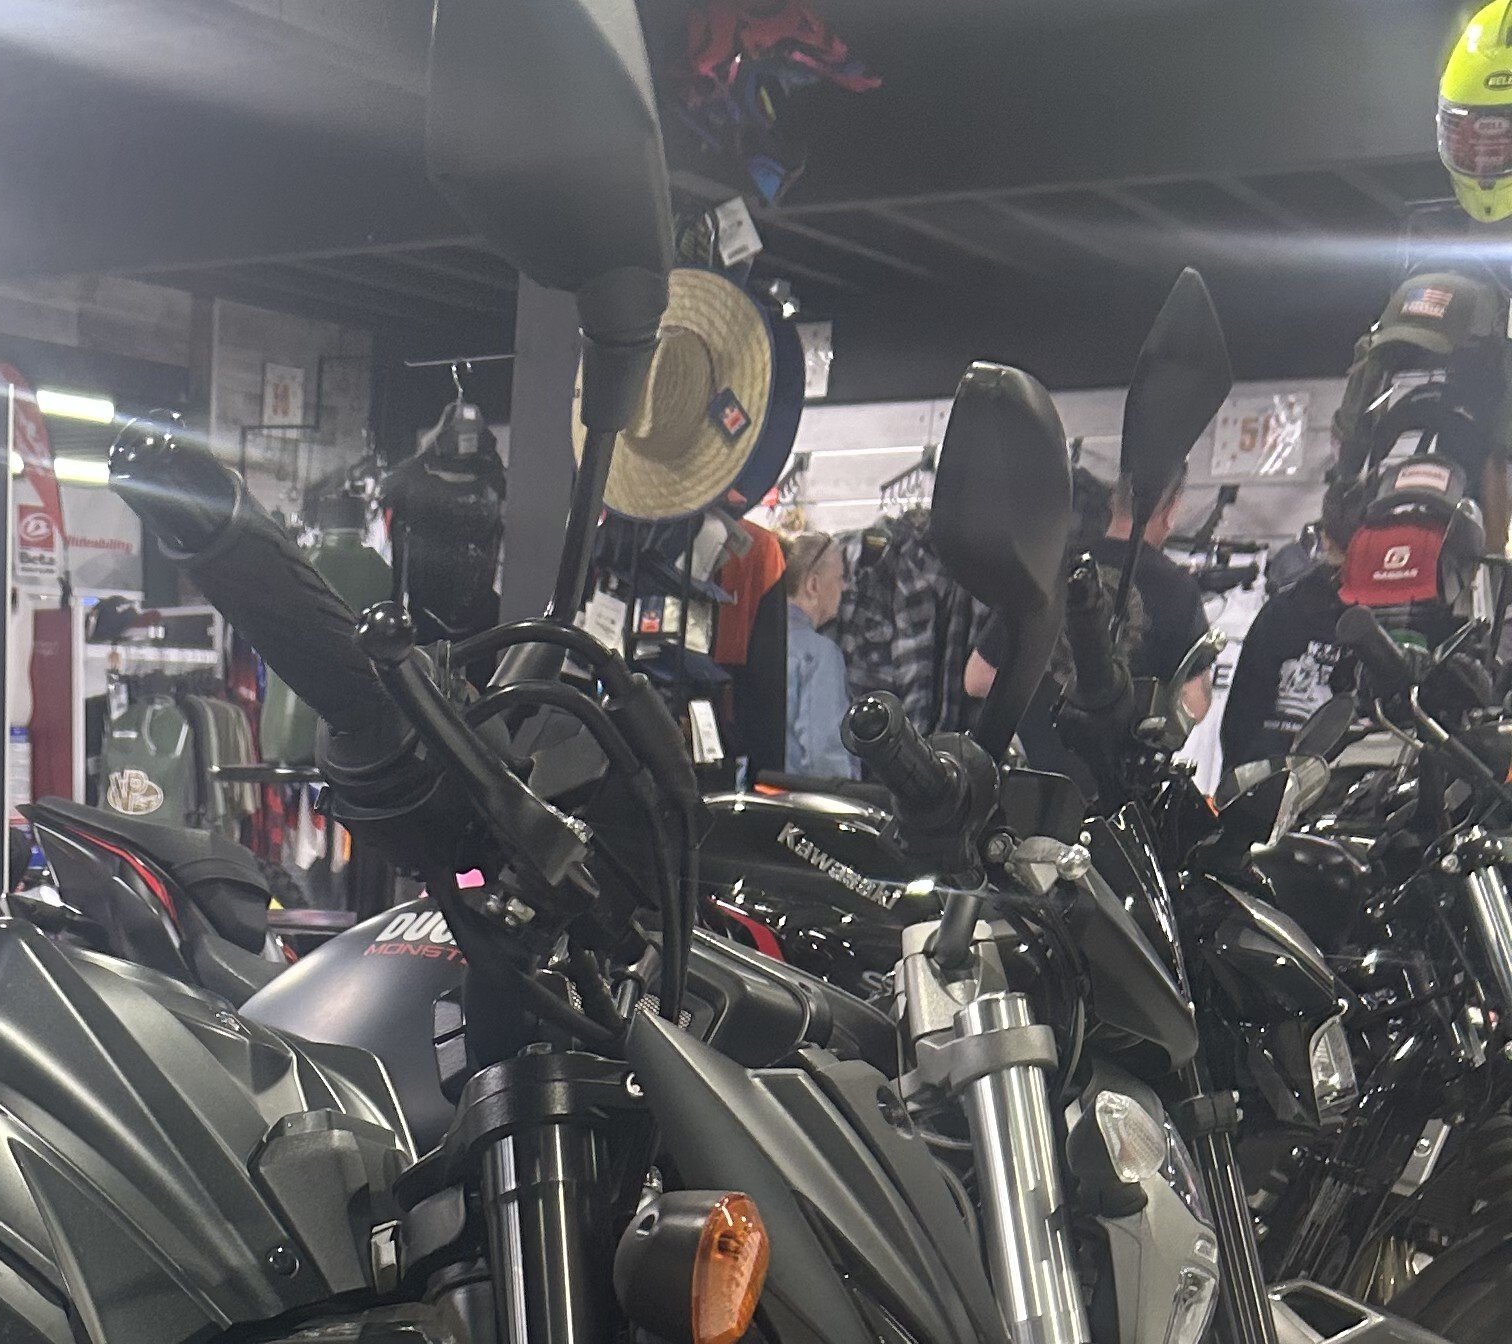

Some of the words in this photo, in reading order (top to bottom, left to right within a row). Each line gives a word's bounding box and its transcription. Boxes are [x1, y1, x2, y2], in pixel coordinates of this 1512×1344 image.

[777, 822, 903, 910] Kawasaki
[375, 911, 457, 946] DUC
[363, 943, 468, 964] MONST
